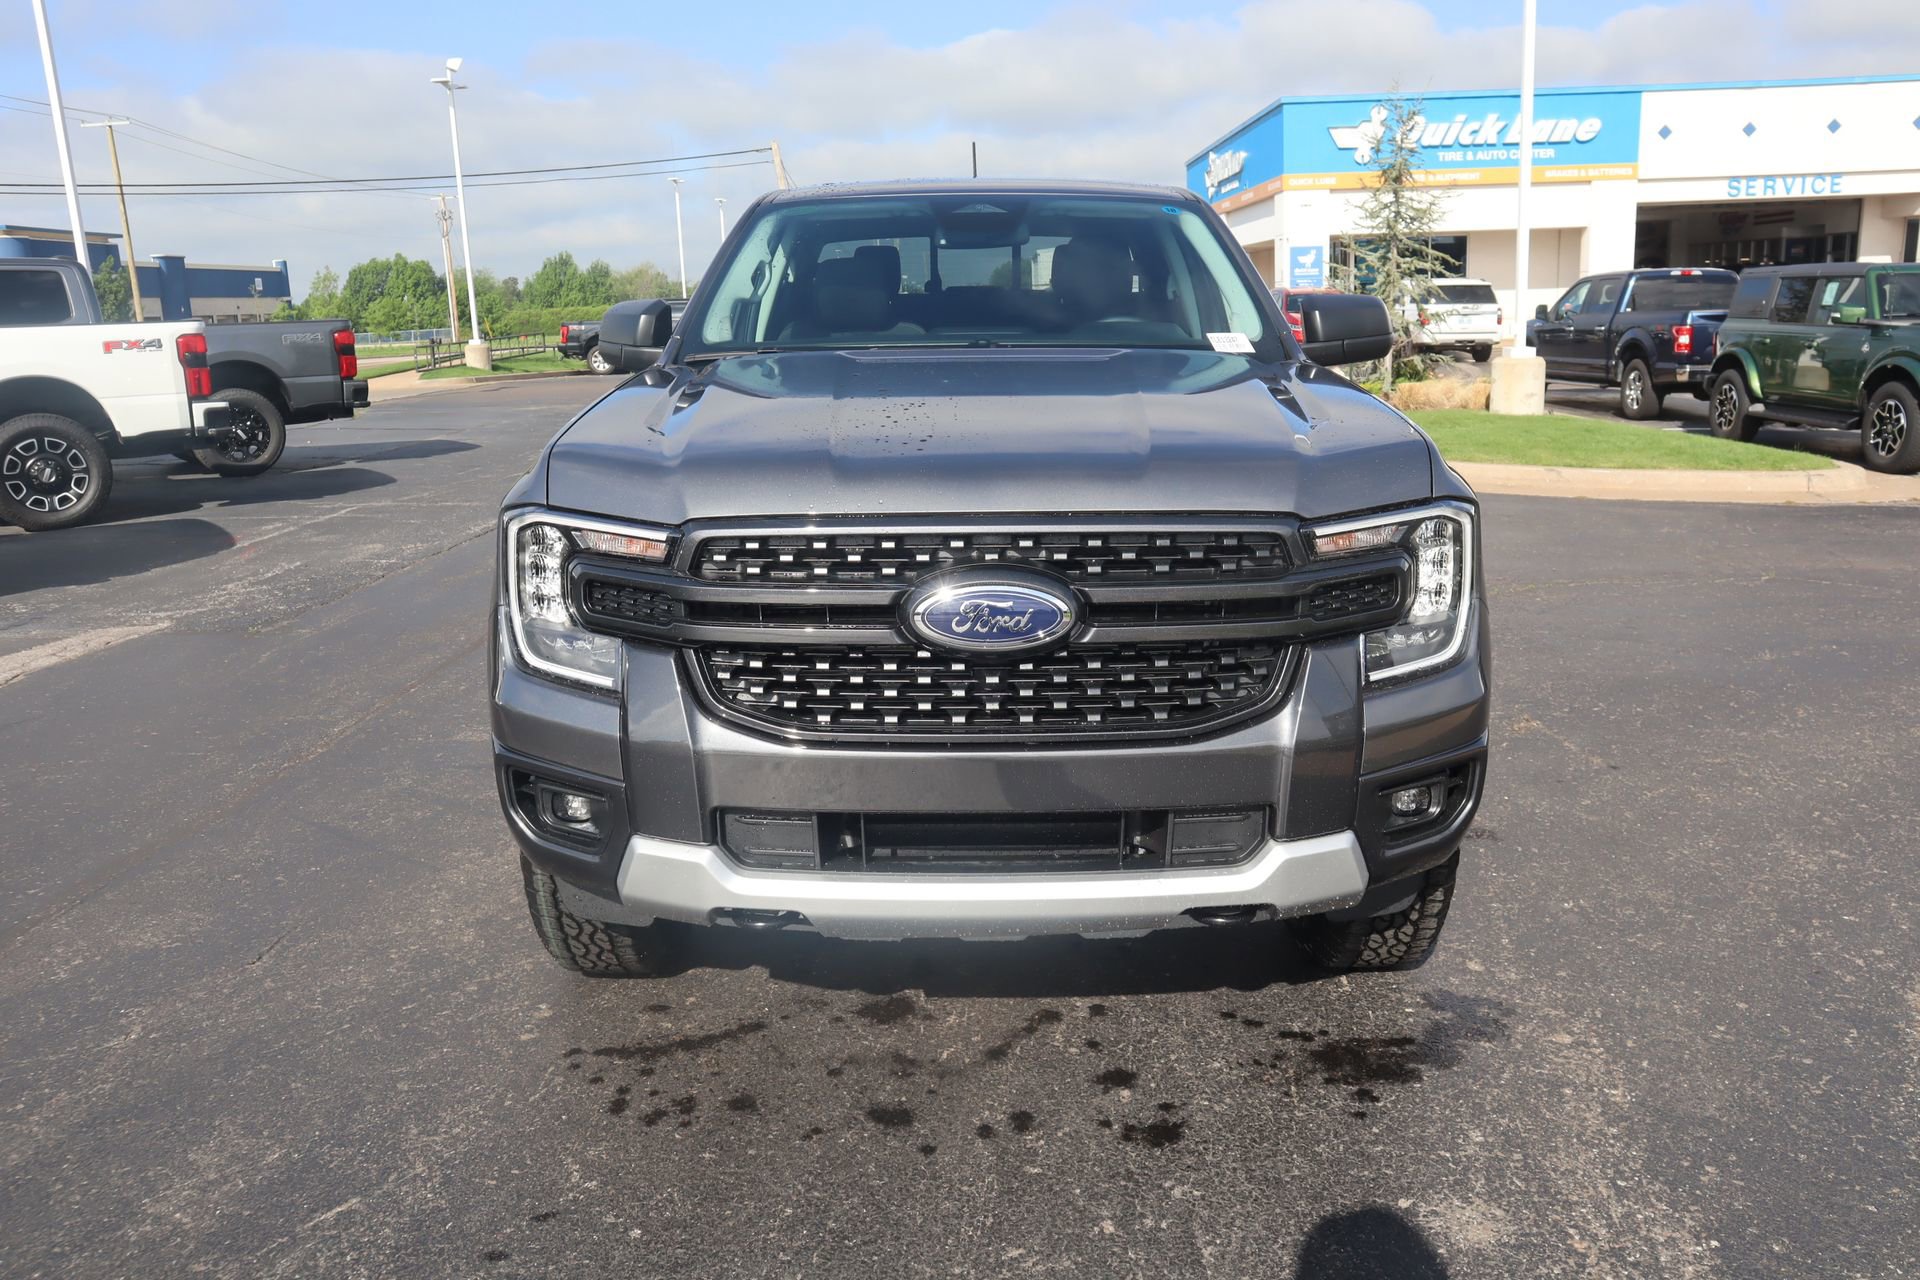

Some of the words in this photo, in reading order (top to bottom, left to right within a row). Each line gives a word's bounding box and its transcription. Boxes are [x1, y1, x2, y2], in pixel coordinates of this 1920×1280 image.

[1396, 113, 1504, 148] Quick
[1503, 113, 1602, 143] Lane
[1437, 151, 1464, 162] TIRE
[1466, 151, 1474, 161] &
[1476, 150, 1507, 161] AUTO
[1509, 148, 1555, 160] CTER
[1727, 174, 1843, 198] SERVICE
[102, 338, 163, 355] FX4
[281, 332, 324, 345] FX4
[951, 599, 1034, 633] Ford
